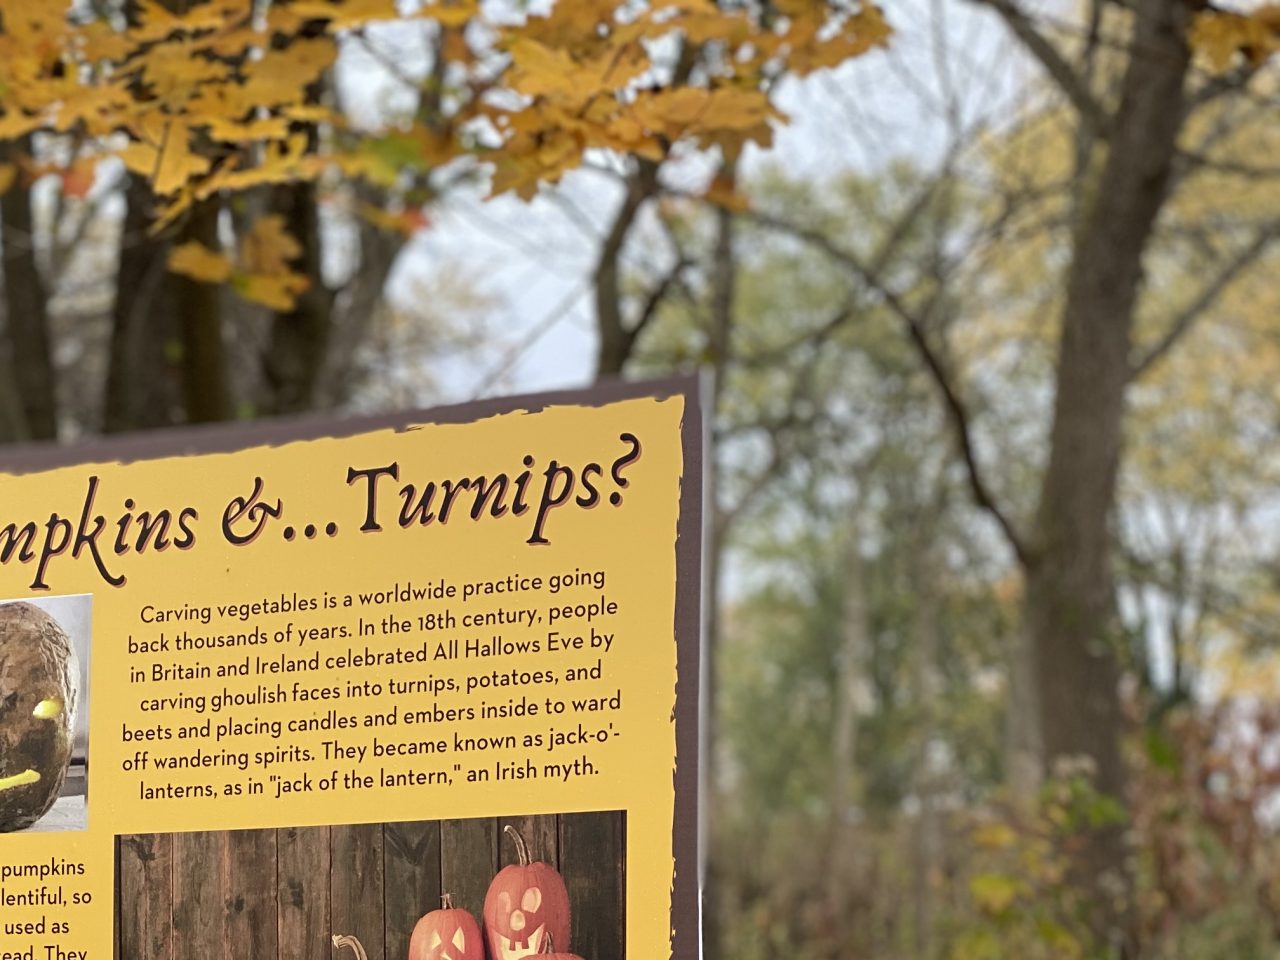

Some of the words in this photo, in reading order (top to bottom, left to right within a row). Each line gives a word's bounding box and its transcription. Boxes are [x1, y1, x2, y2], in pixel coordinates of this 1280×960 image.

[140, 603, 212, 625] Carving
[217, 592, 318, 622] vegetables
[323, 591, 338, 609] is
[342, 594, 353, 608] a
[358, 578, 457, 606] worldwide
[462, 573, 543, 602] practice
[548, 567, 605, 595] going
[128, 632, 170, 654] back
[175, 625, 268, 651] thousands
[273, 622, 294, 644] of
[297, 625, 353, 647] years.
[358, 617, 375, 637] In
[380, 613, 412, 635] the
[417, 609, 456, 632] 18th
[462, 607, 543, 628] century,
[548, 594, 618, 626] people
[130, 666, 146, 683] in
[151, 661, 211, 682] Britain
[216, 656, 250, 678] and
[255, 650, 320, 675] Ireland
[325, 641, 428, 670] celebrated
[433, 639, 459, 661] All
[465, 635, 541, 659] Hallows
[547, 631, 584, 652] Eve
[590, 627, 615, 653] by
[140, 692, 206, 714] carving
[210, 683, 287, 713] ghoulish
[291, 681, 341, 702] faces
[346, 680, 383, 698] into
[388, 674, 461, 697] turnips,
[466, 669, 559, 695] potatoes,
[564, 658, 602, 682] and
[122, 723, 173, 742] beets
[177, 718, 211, 740] and
[216, 716, 282, 742] placing
[287, 709, 358, 733] candles
[363, 705, 398, 728] and
[403, 702, 476, 725] embers
[481, 696, 539, 719] inside
[544, 697, 566, 715] to
[571, 689, 621, 712] ward
[122, 750, 149, 772] off
[153, 748, 249, 771] wandering
[254, 744, 316, 769] spirits.
[321, 739, 368, 764] They
[373, 737, 448, 757] became
[453, 731, 517, 752] known
[522, 733, 544, 748] as
[140, 780, 218, 800] lanterns,
[223, 783, 243, 796] as
[248, 777, 264, 795] in
[318, 769, 339, 791] of
[343, 769, 375, 790] the
[466, 768, 489, 783] an
[496, 758, 538, 781] Irish
[543, 754, 599, 783] myth.
[1, 856, 86, 883] pumpkins
[72, 892, 93, 905] so
[4, 915, 46, 936] used
[51, 921, 70, 935] as
